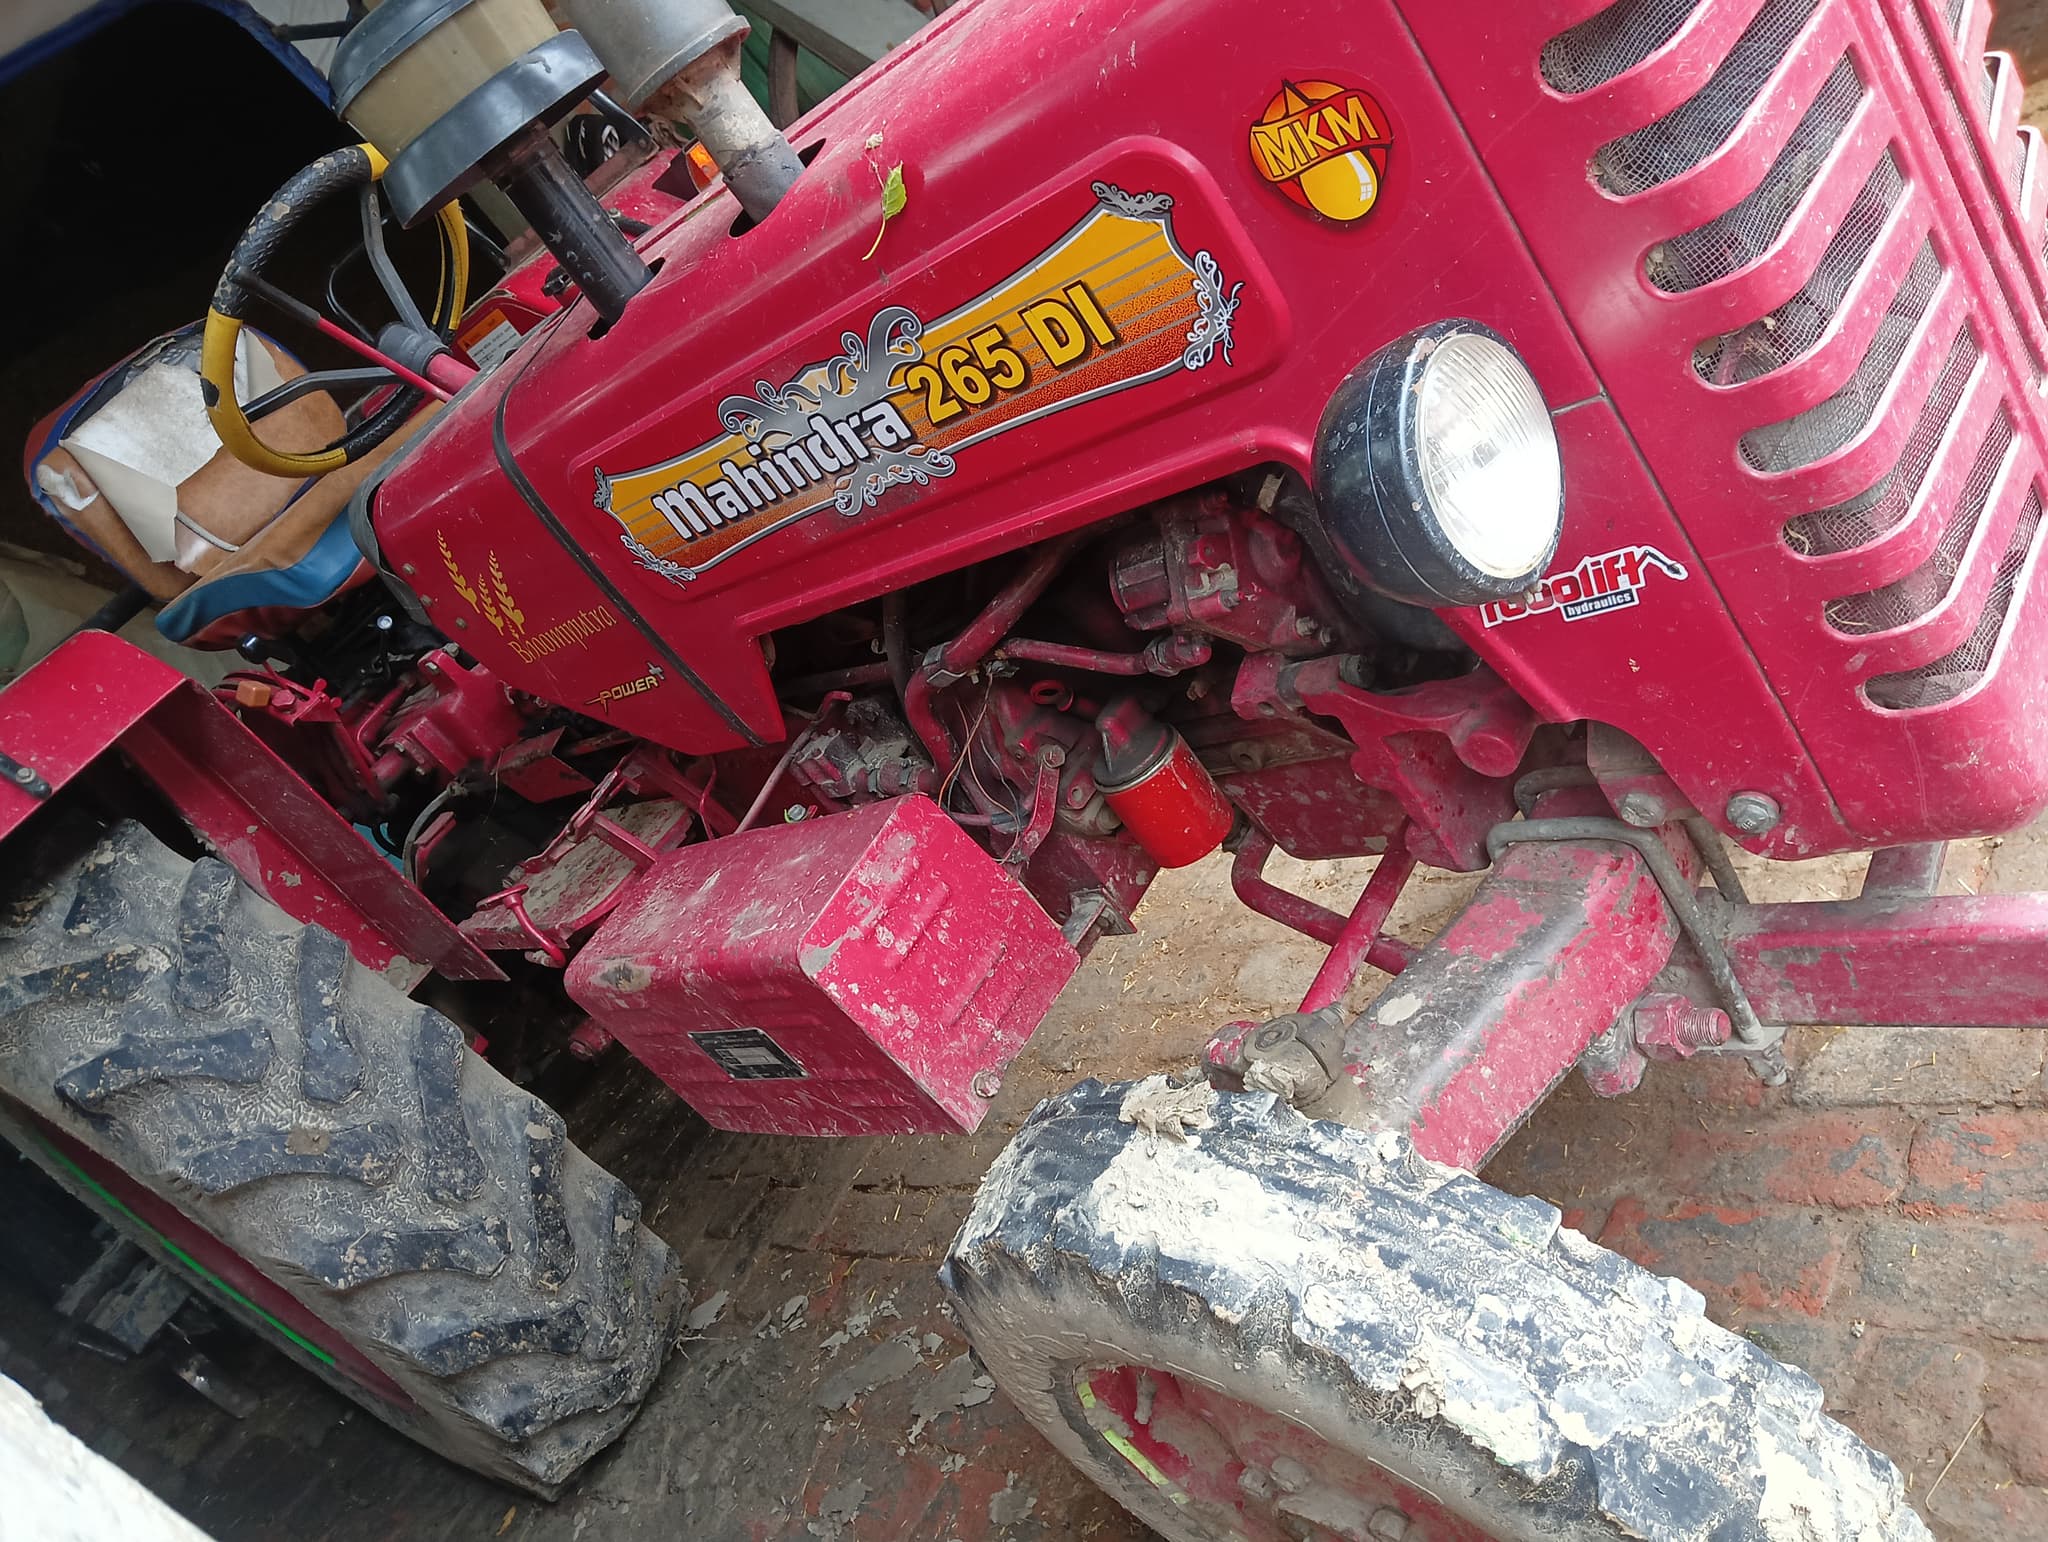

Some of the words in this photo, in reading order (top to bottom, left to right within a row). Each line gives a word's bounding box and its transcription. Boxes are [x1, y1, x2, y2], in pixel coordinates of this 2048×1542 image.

[1254, 96, 1380, 178] MKM
[652, 396, 912, 540] Mahindra
[905, 325, 1027, 427] 265
[1017, 281, 1120, 373] DI
[1566, 591, 1632, 618] hydraulics
